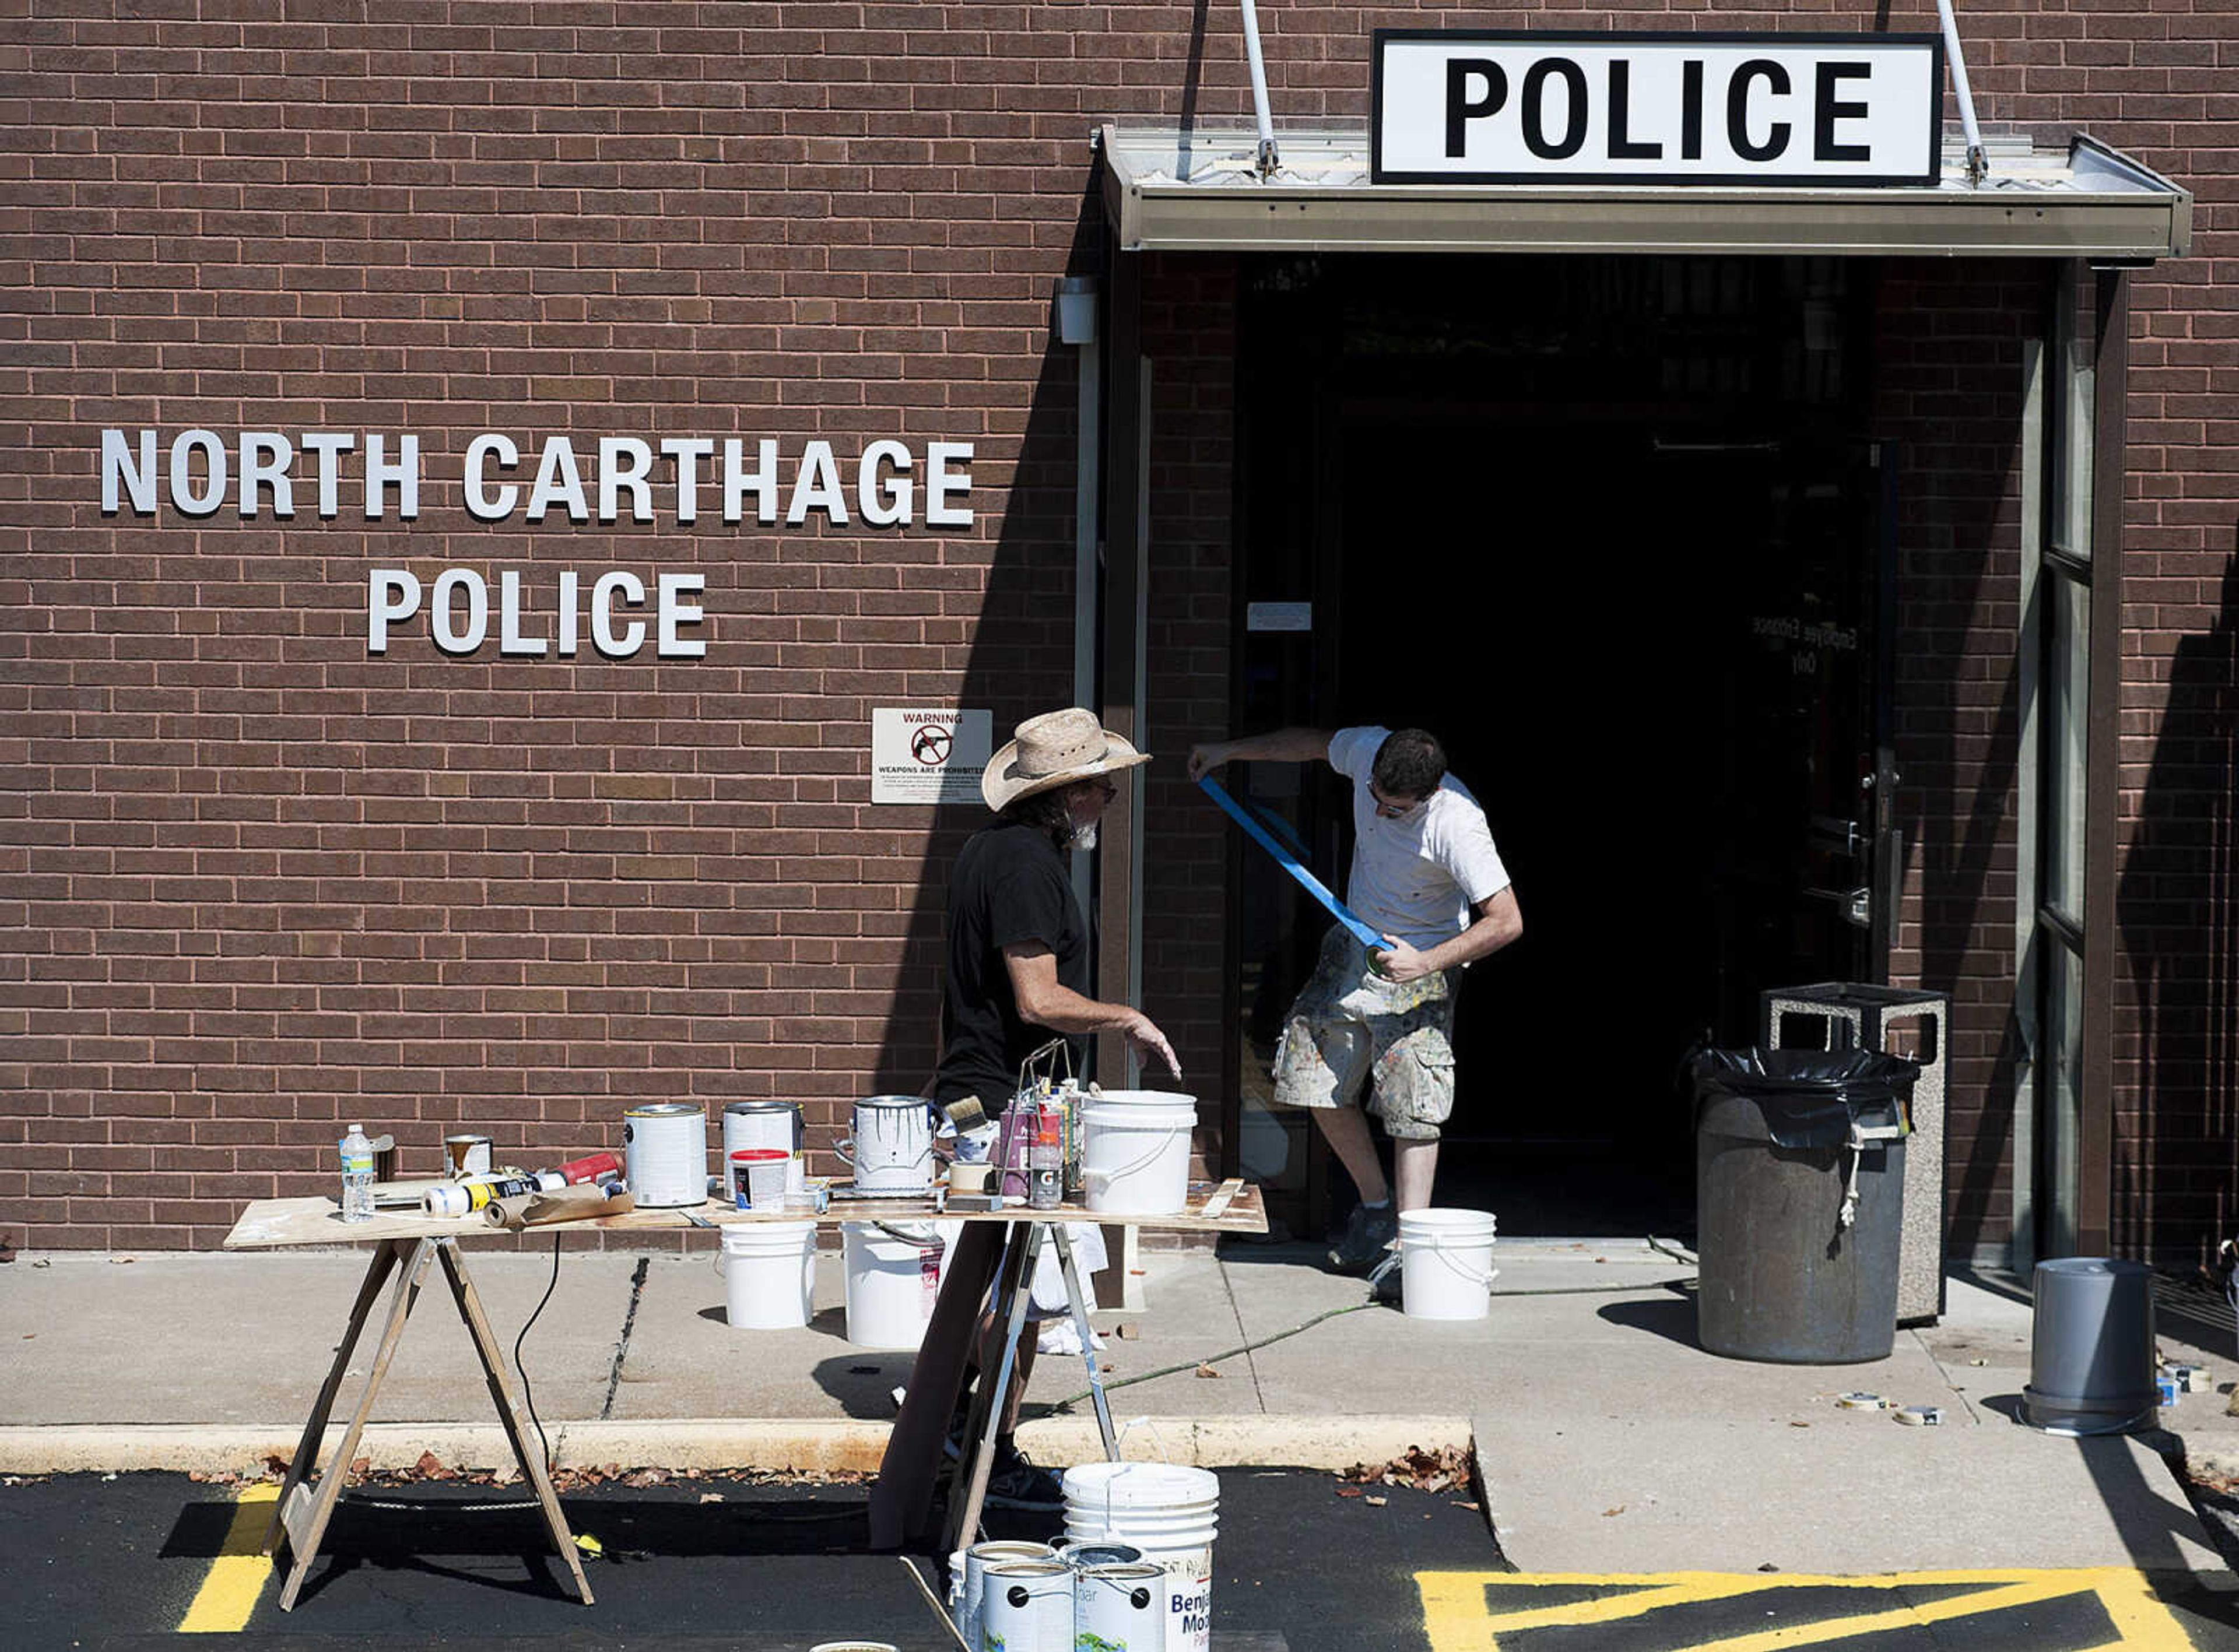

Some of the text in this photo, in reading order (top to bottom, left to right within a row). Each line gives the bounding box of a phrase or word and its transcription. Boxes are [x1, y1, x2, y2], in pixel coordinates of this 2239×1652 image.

[1445, 58, 1872, 162] POLICE
[101, 428, 975, 529] NORTH CARTHAGE
[369, 569, 707, 657] POLICE
[903, 713, 963, 724] WARNING
[1041, 1172, 1054, 1186] G
